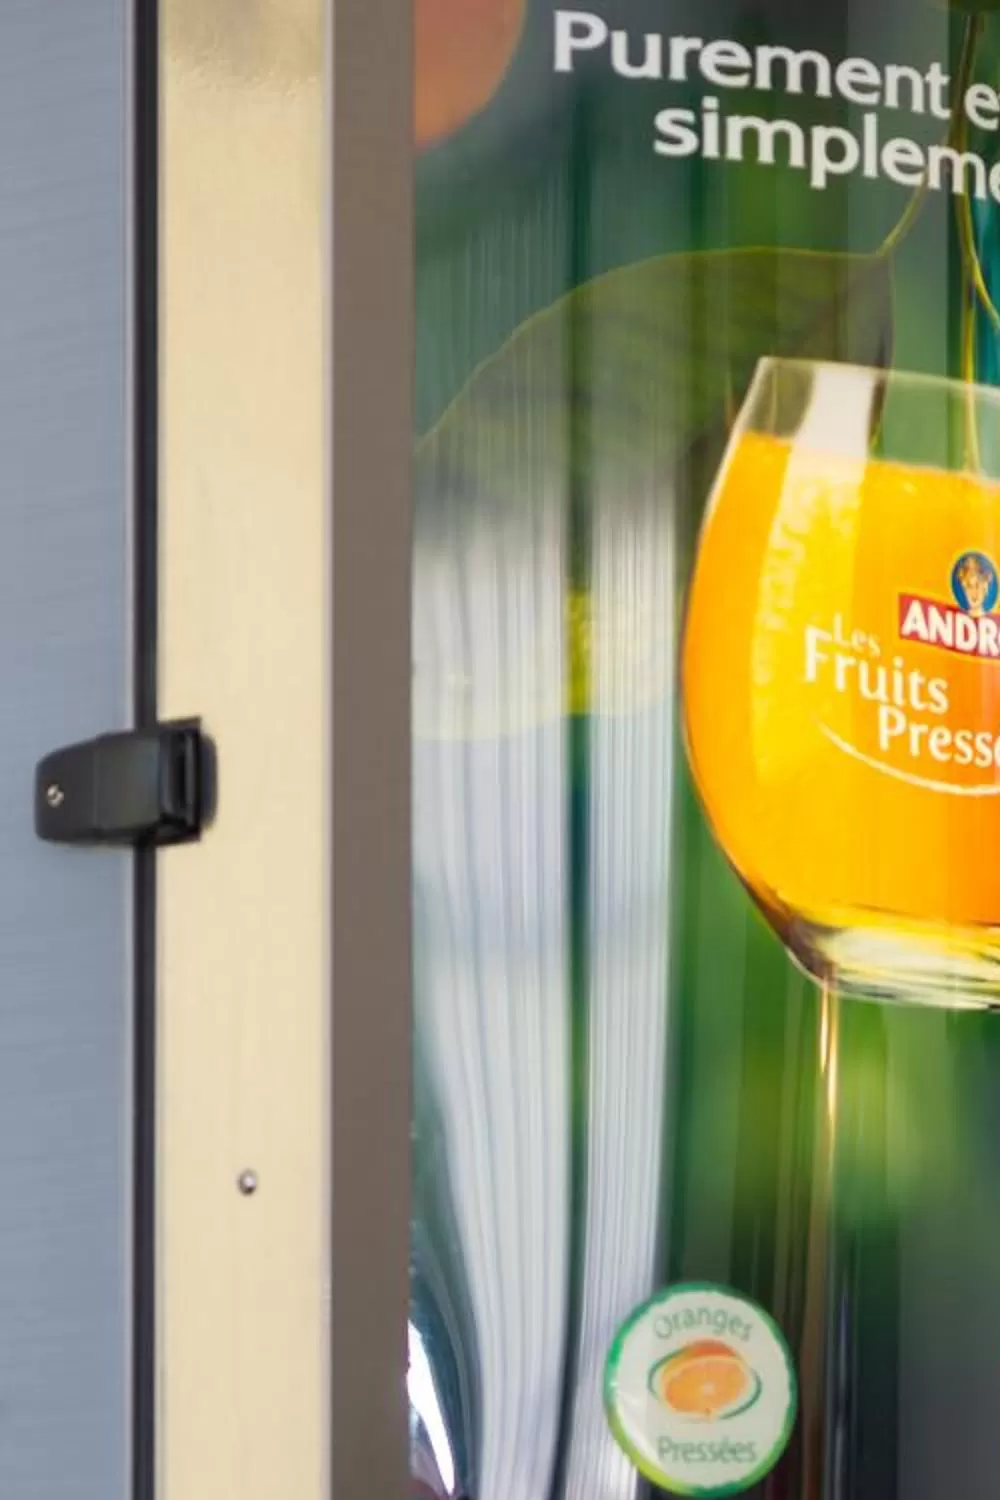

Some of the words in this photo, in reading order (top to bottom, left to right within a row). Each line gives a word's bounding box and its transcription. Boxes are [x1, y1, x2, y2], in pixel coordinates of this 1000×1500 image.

[553, 10, 951, 114] Purement
[832, 613, 881, 656] Les
[804, 626, 949, 714] Fruits
[653, 1306, 753, 1342] Oranges
[656, 1435, 757, 1464] Pressées
